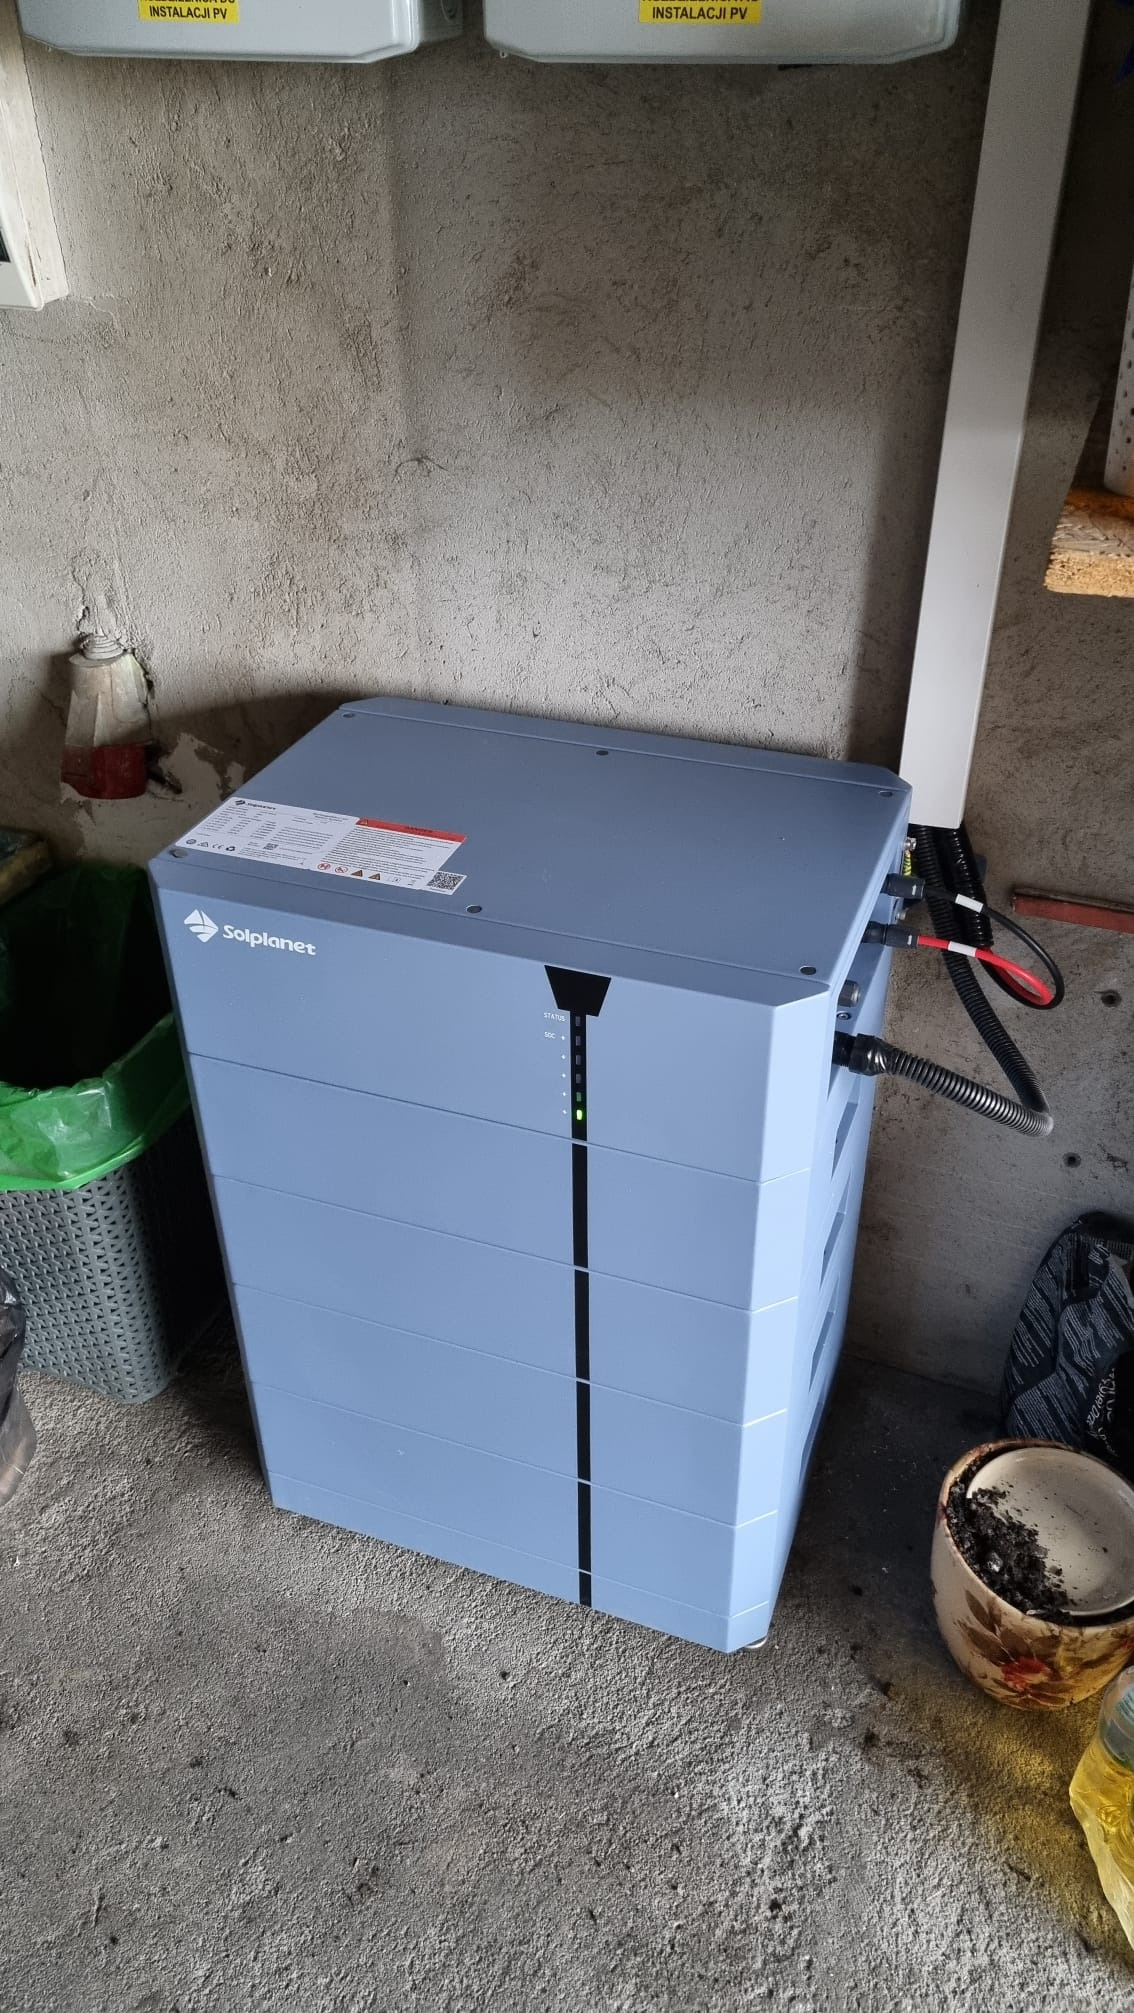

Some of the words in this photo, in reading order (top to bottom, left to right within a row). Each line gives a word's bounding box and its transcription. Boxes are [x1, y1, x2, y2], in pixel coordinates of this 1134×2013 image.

[149, 5, 210, 19] INSTALACJI
[213, 8, 228, 19] PV
[652, 6, 727, 19] INSTALACJI
[730, 7, 748, 19] PV
[222, 924, 317, 956] Solplanet
[543, 1012, 566, 1022] STATUS
